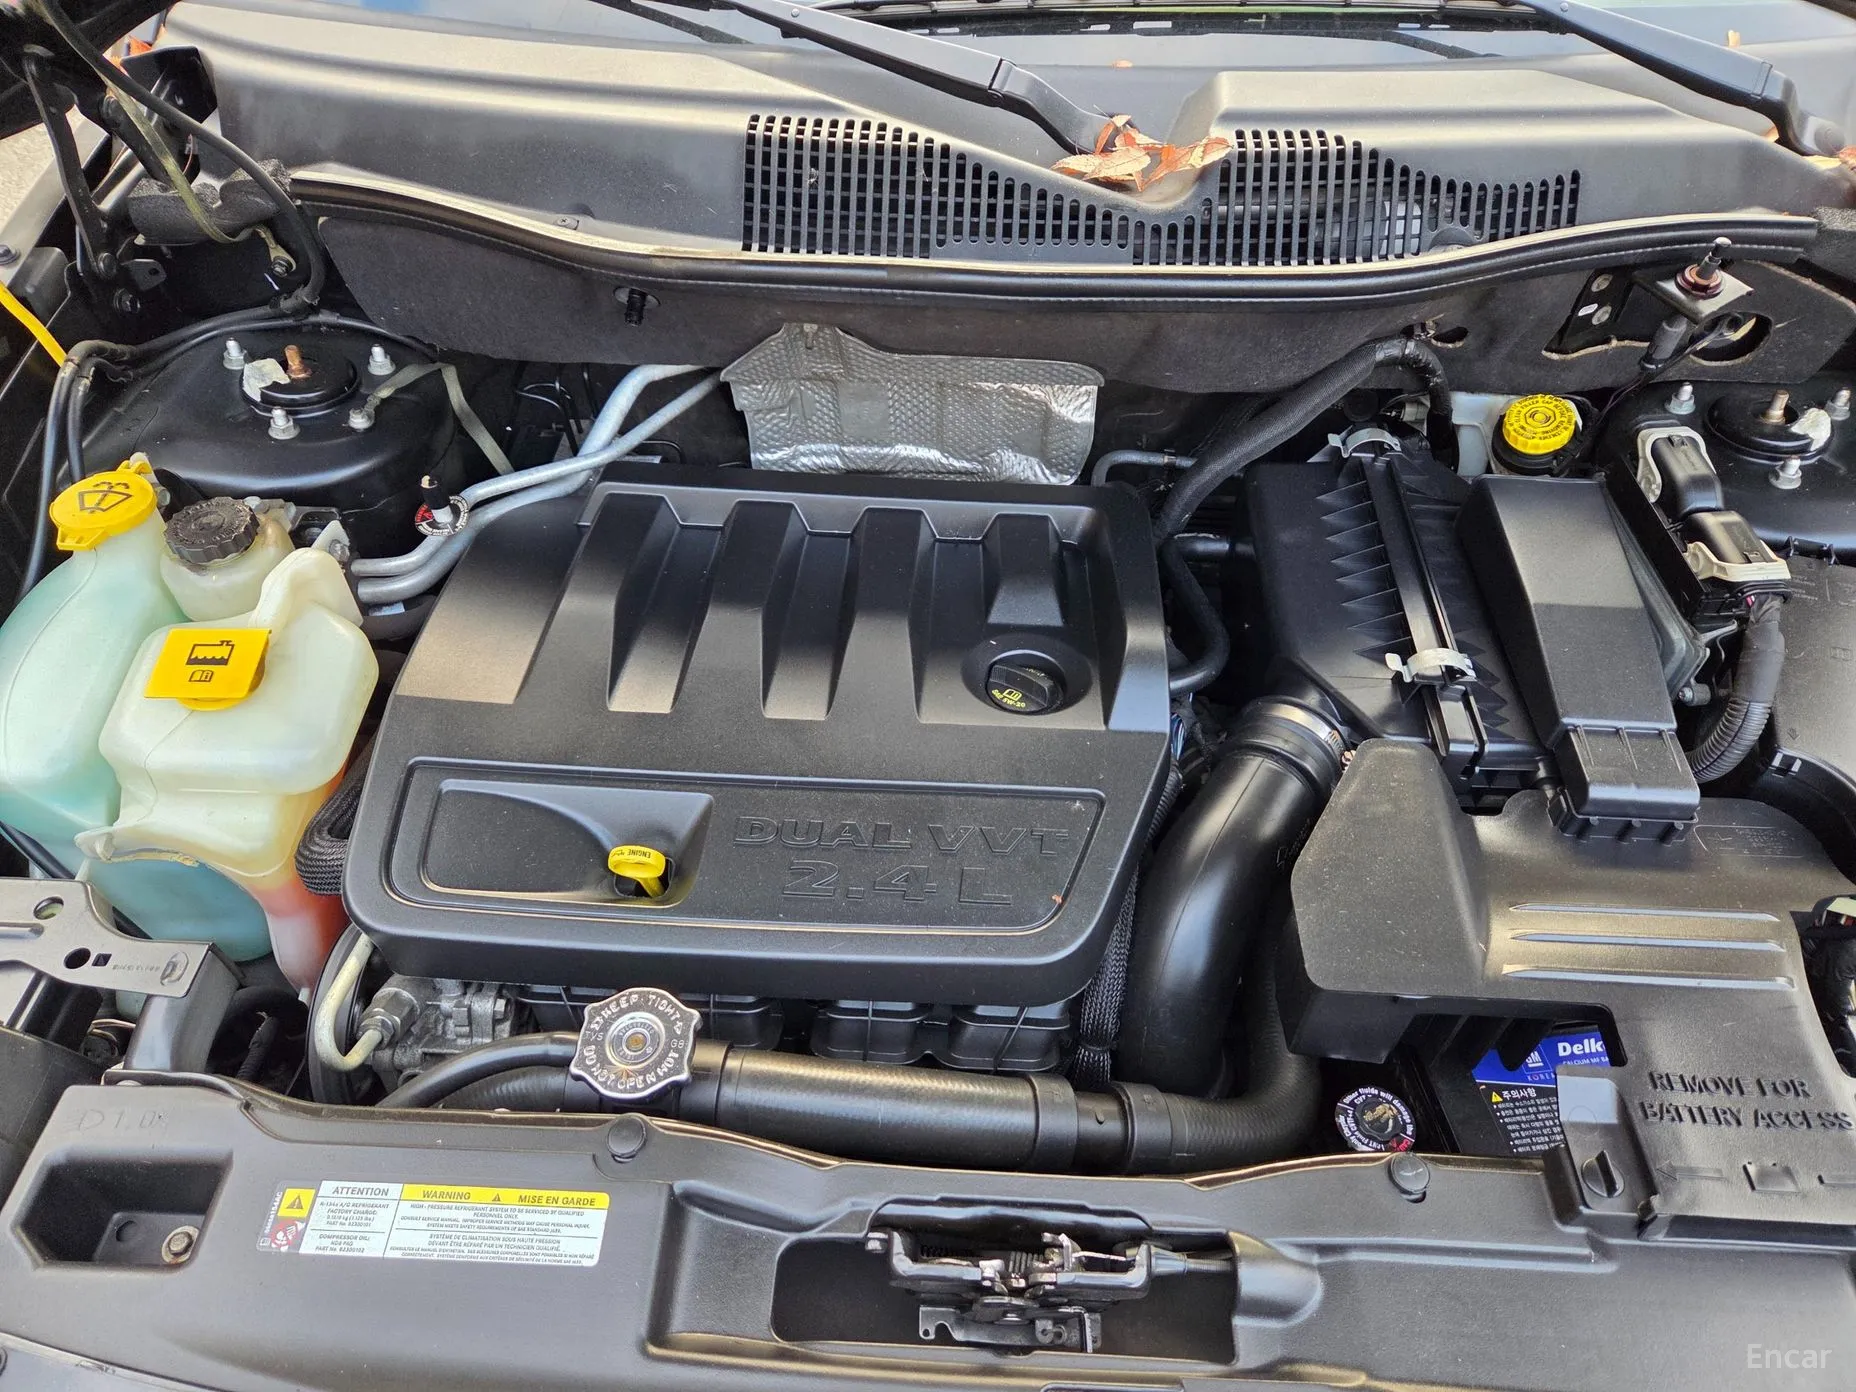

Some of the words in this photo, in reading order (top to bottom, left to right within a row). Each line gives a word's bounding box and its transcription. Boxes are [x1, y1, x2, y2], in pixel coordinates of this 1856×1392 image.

[733, 816, 912, 850] DUAL
[928, 824, 1069, 856] VVT
[627, 849, 652, 858] ENGINE
[601, 994, 639, 1019] KEEP
[648, 994, 681, 1021] TIGHT
[1558, 1038, 1605, 1056] Delk
[618, 1071, 656, 1090] OPEN
[656, 1050, 679, 1076] HOT
[1649, 1071, 1753, 1098] REMOVE
[1756, 1078, 1813, 1099] FOR
[1380, 1091, 1394, 1101] will
[1502, 1088, 1537, 1100] 주의사항
[1640, 1101, 1744, 1128] BATTERY
[1754, 1108, 1855, 1131] ACCESS
[332, 1186, 390, 1196] ATTENTION
[422, 1190, 471, 1200] WARNING
[518, 1194, 544, 1204] MISE
[546, 1196, 559, 1204] EN
[562, 1196, 596, 1206] GARDE
